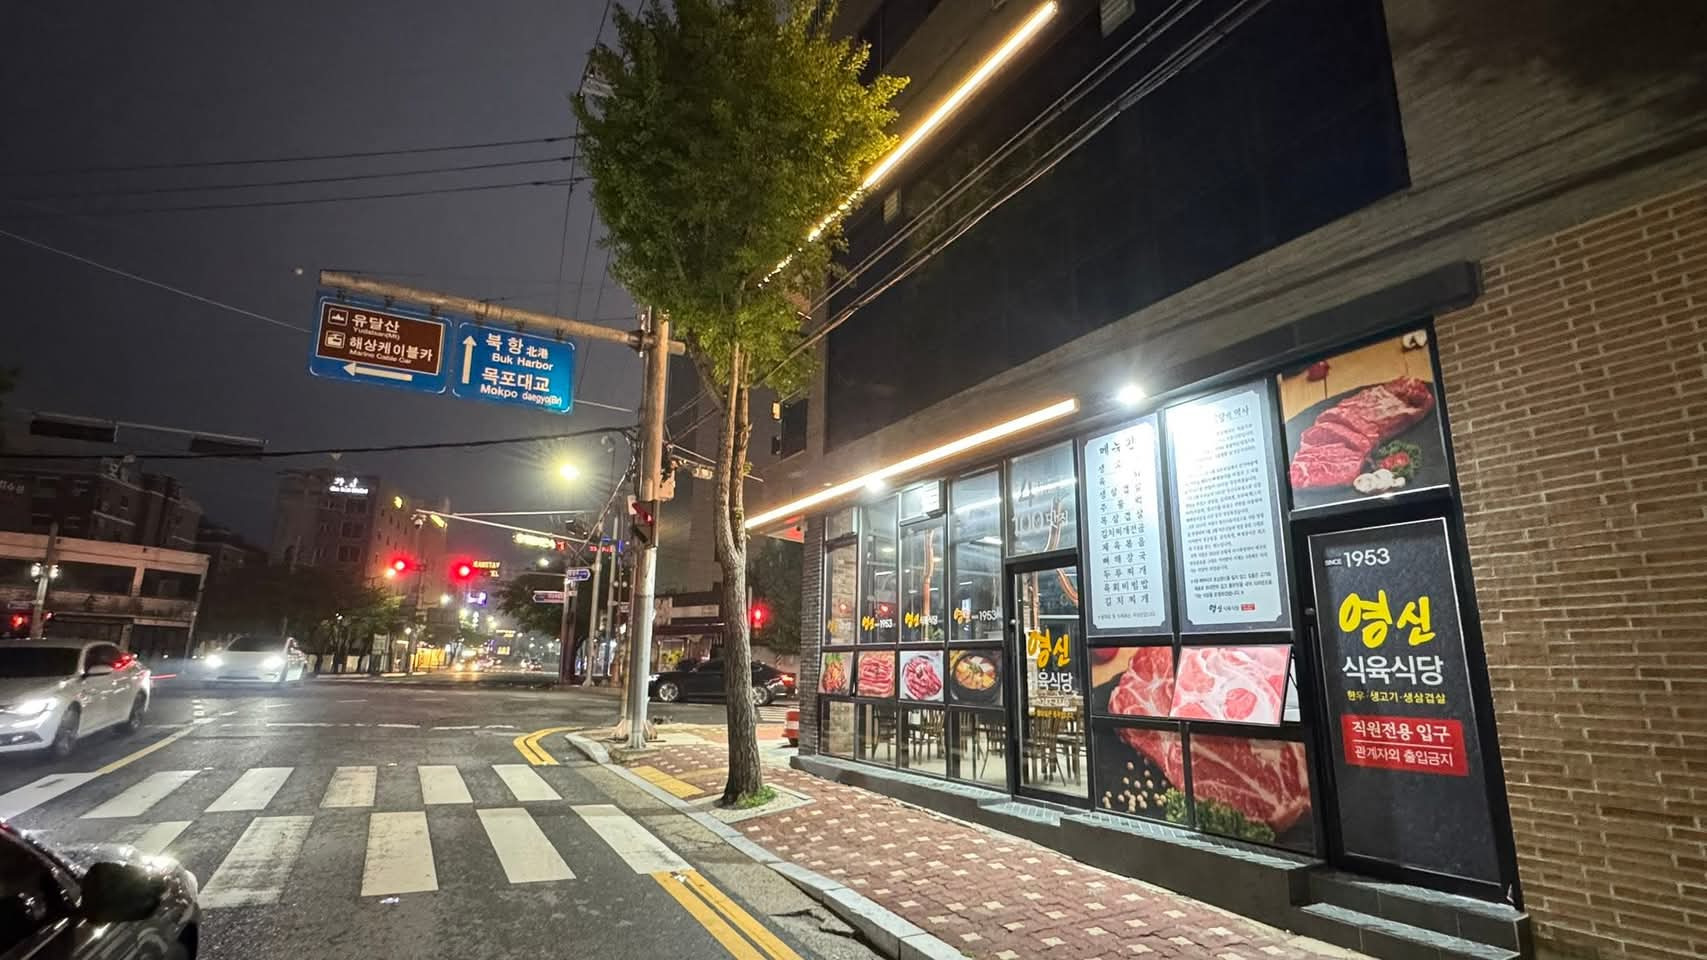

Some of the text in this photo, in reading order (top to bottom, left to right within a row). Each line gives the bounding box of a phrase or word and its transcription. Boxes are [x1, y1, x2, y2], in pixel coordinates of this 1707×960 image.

[351, 313, 400, 334] 유달산
[349, 336, 433, 362] 해상케이블카
[349, 348, 413, 364] Marine Cable Car
[527, 345, 549, 360] 北港
[492, 352, 554, 371] Buk Harbor
[482, 367, 550, 392] 목포대교
[480, 383, 562, 407] Mokpo daegyo(Br)
[1325, 547, 1391, 568] SINCE 1953
[1338, 589, 1436, 649] 영신
[1027, 628, 1071, 668] 영신
[1342, 655, 1444, 686] 식육식당
[1352, 721, 1451, 742] 직원전용 입구
[1355, 746, 1453, 767] 관계자외 출입금지
